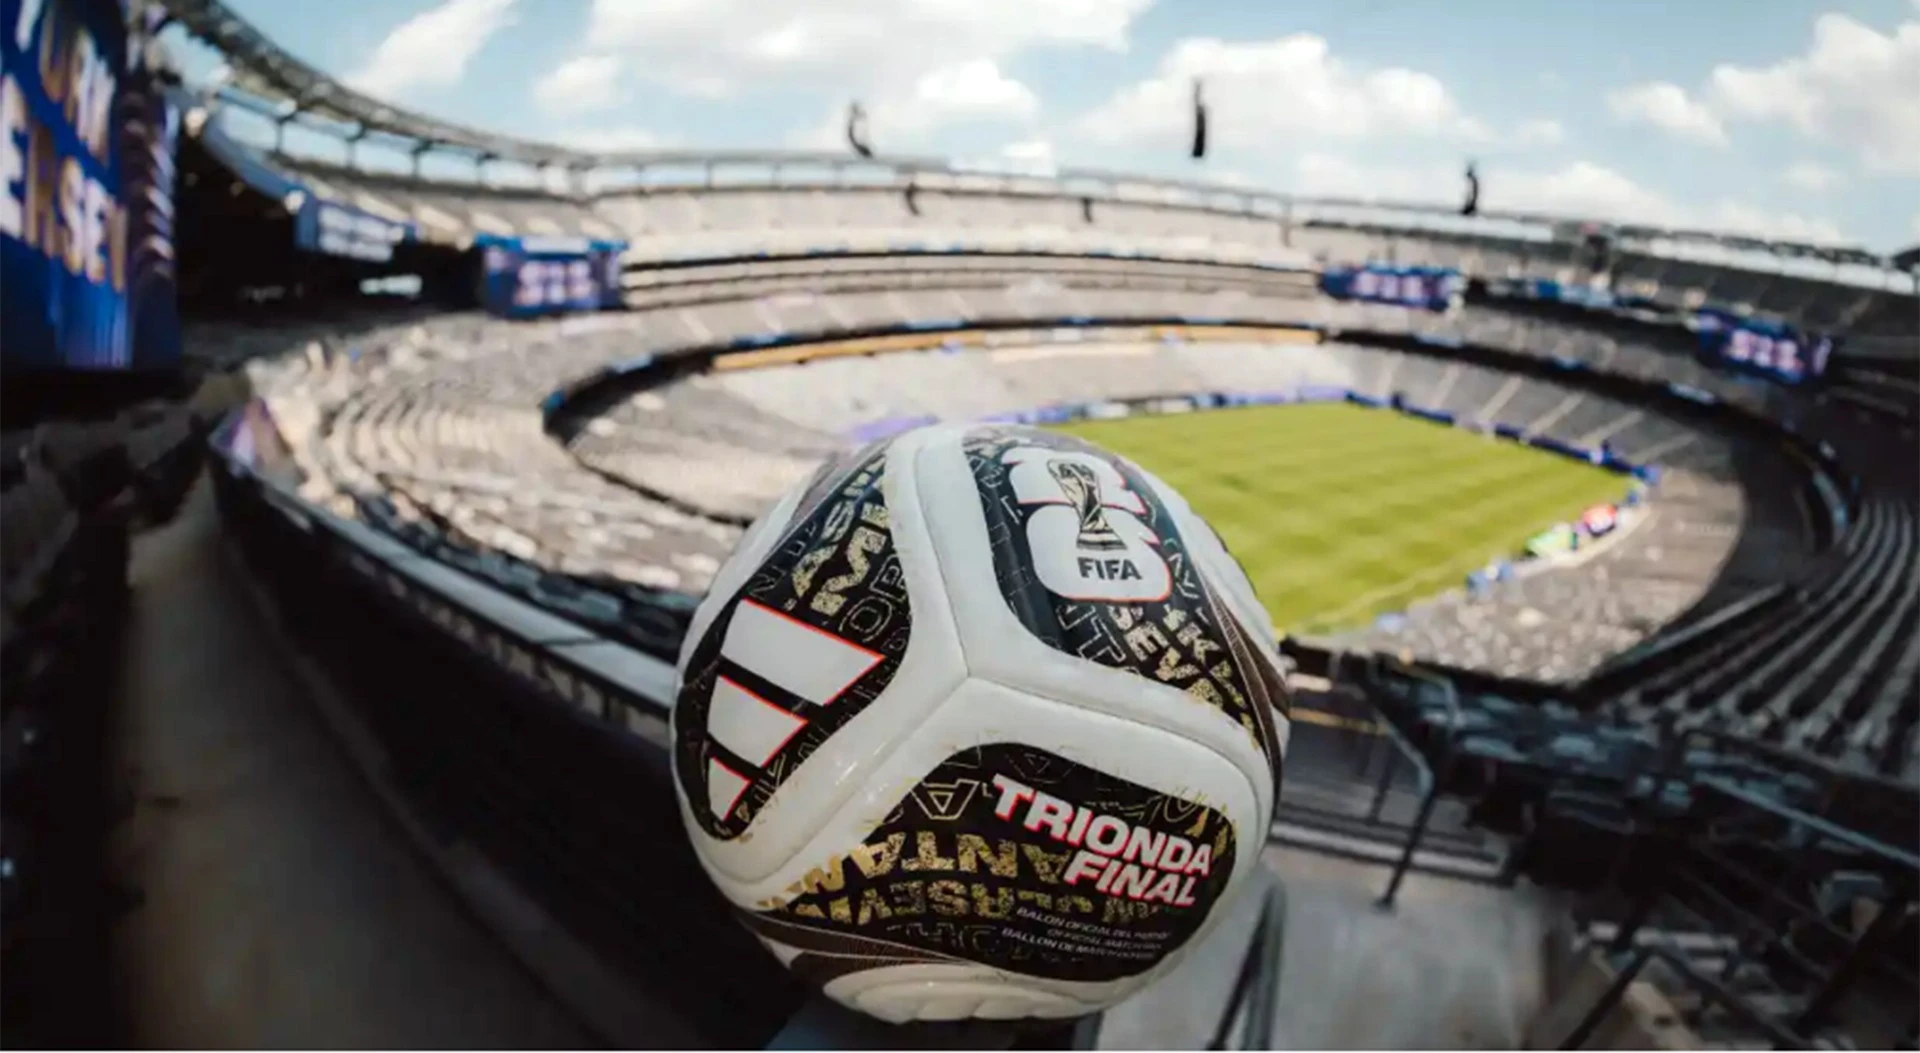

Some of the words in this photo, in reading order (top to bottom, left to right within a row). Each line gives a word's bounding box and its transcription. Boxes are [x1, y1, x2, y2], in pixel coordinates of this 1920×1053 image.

[1077, 557, 1142, 581] FIFA
[992, 773, 1212, 877] TRIONDA
[1063, 851, 1198, 906] FINAL
